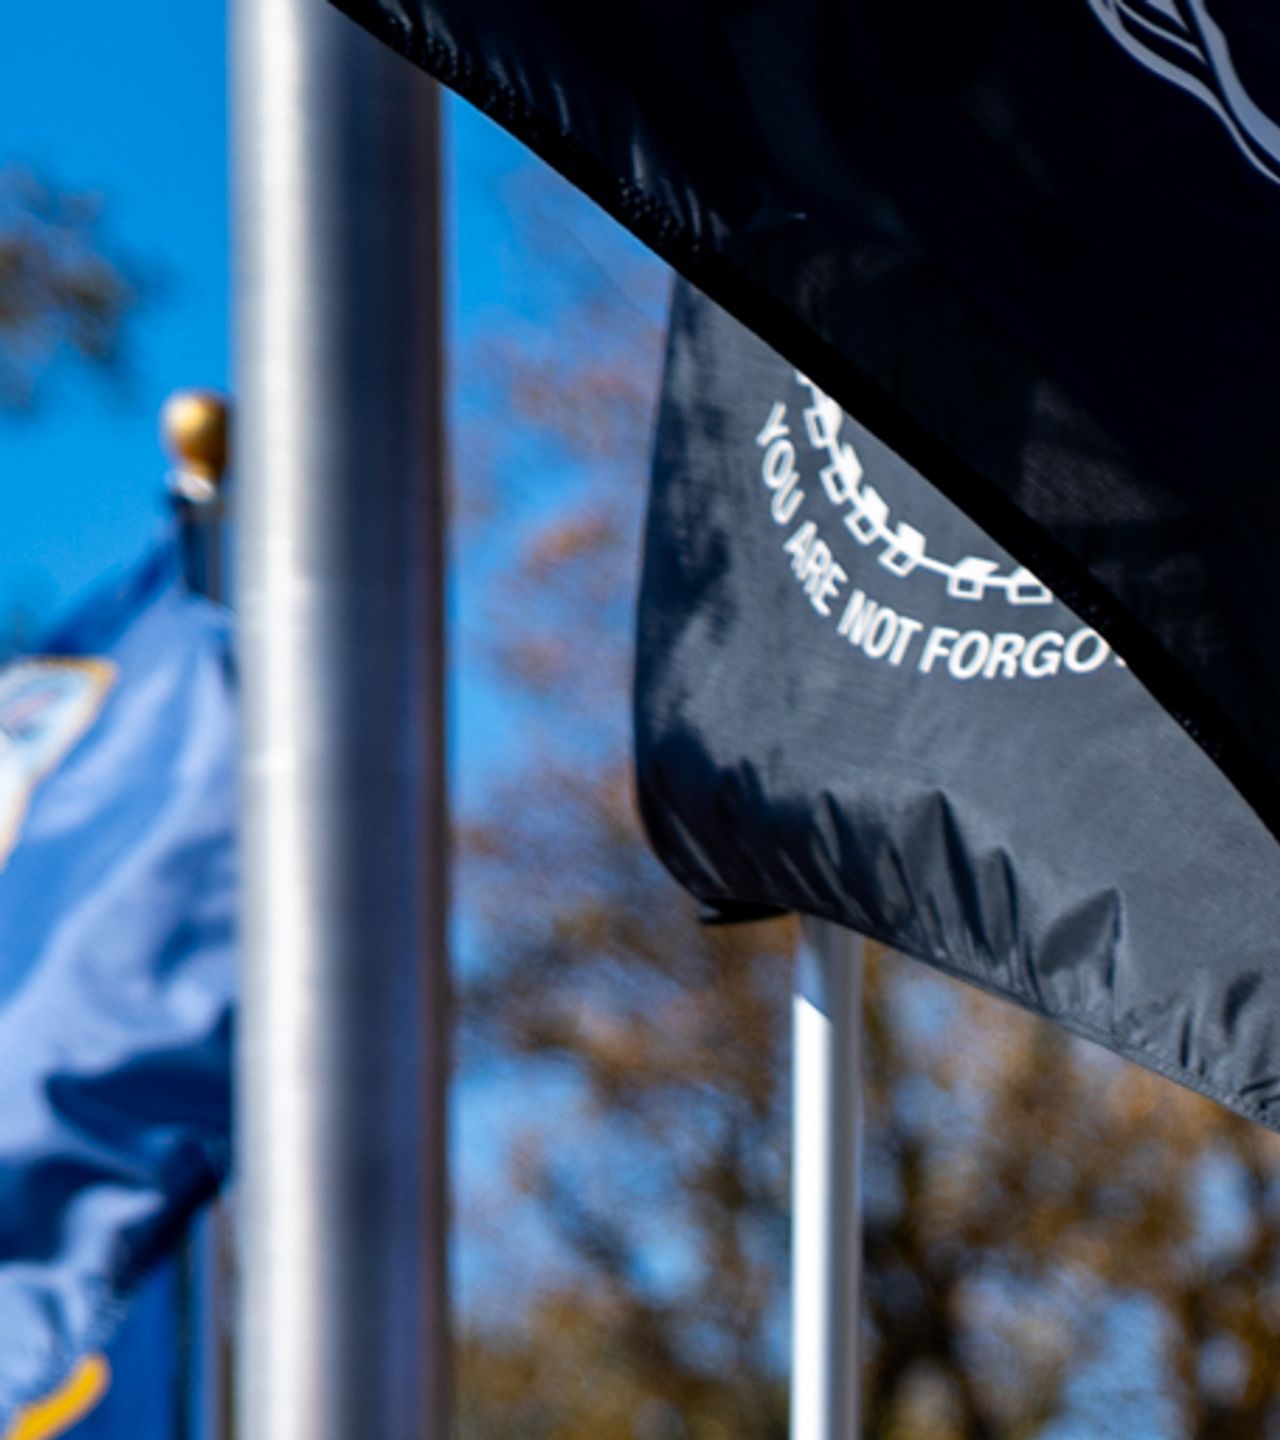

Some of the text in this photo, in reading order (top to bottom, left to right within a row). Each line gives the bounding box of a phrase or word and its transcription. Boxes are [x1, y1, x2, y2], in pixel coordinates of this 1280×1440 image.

[756, 401, 1126, 679] YOU ARE NOT FORGO
